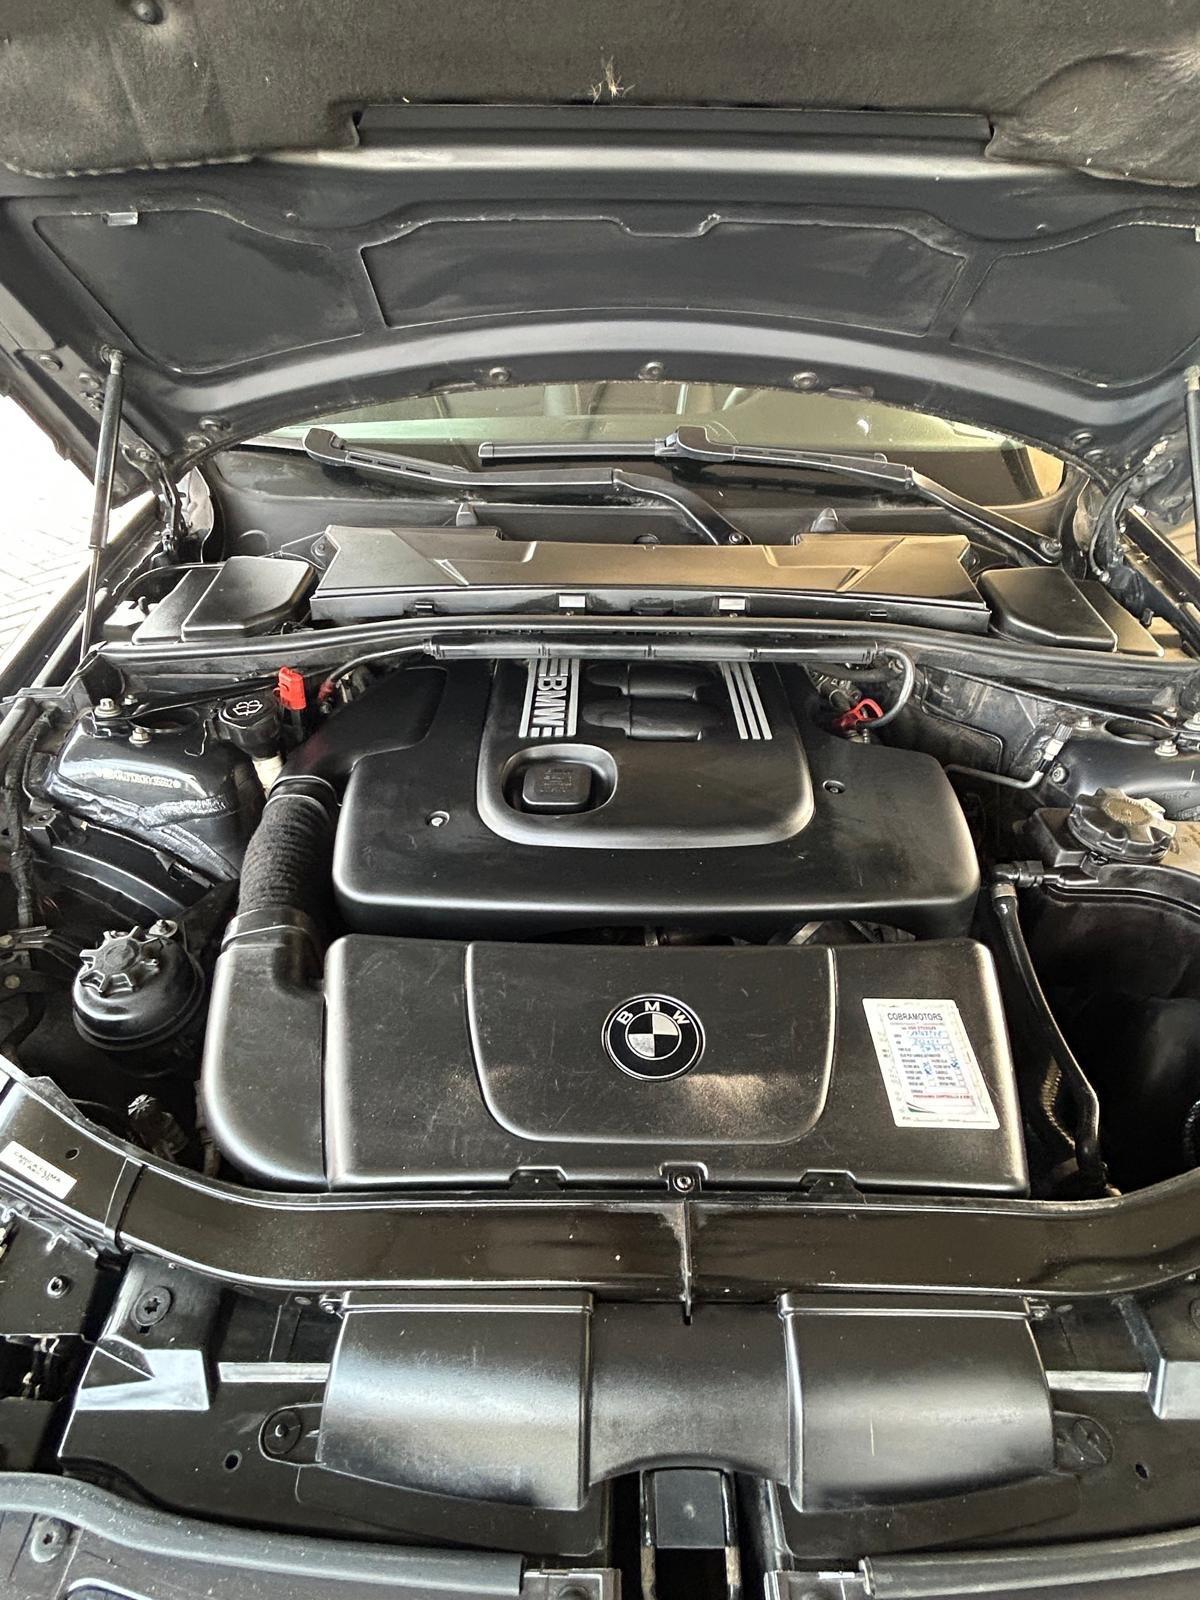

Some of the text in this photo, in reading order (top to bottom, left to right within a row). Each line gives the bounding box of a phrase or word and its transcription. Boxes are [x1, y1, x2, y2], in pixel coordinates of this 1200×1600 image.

[532, 675, 569, 726] BMW
[616, 1001, 691, 1025] BMW
[887, 1012, 943, 1021] COBRAMOTORS
